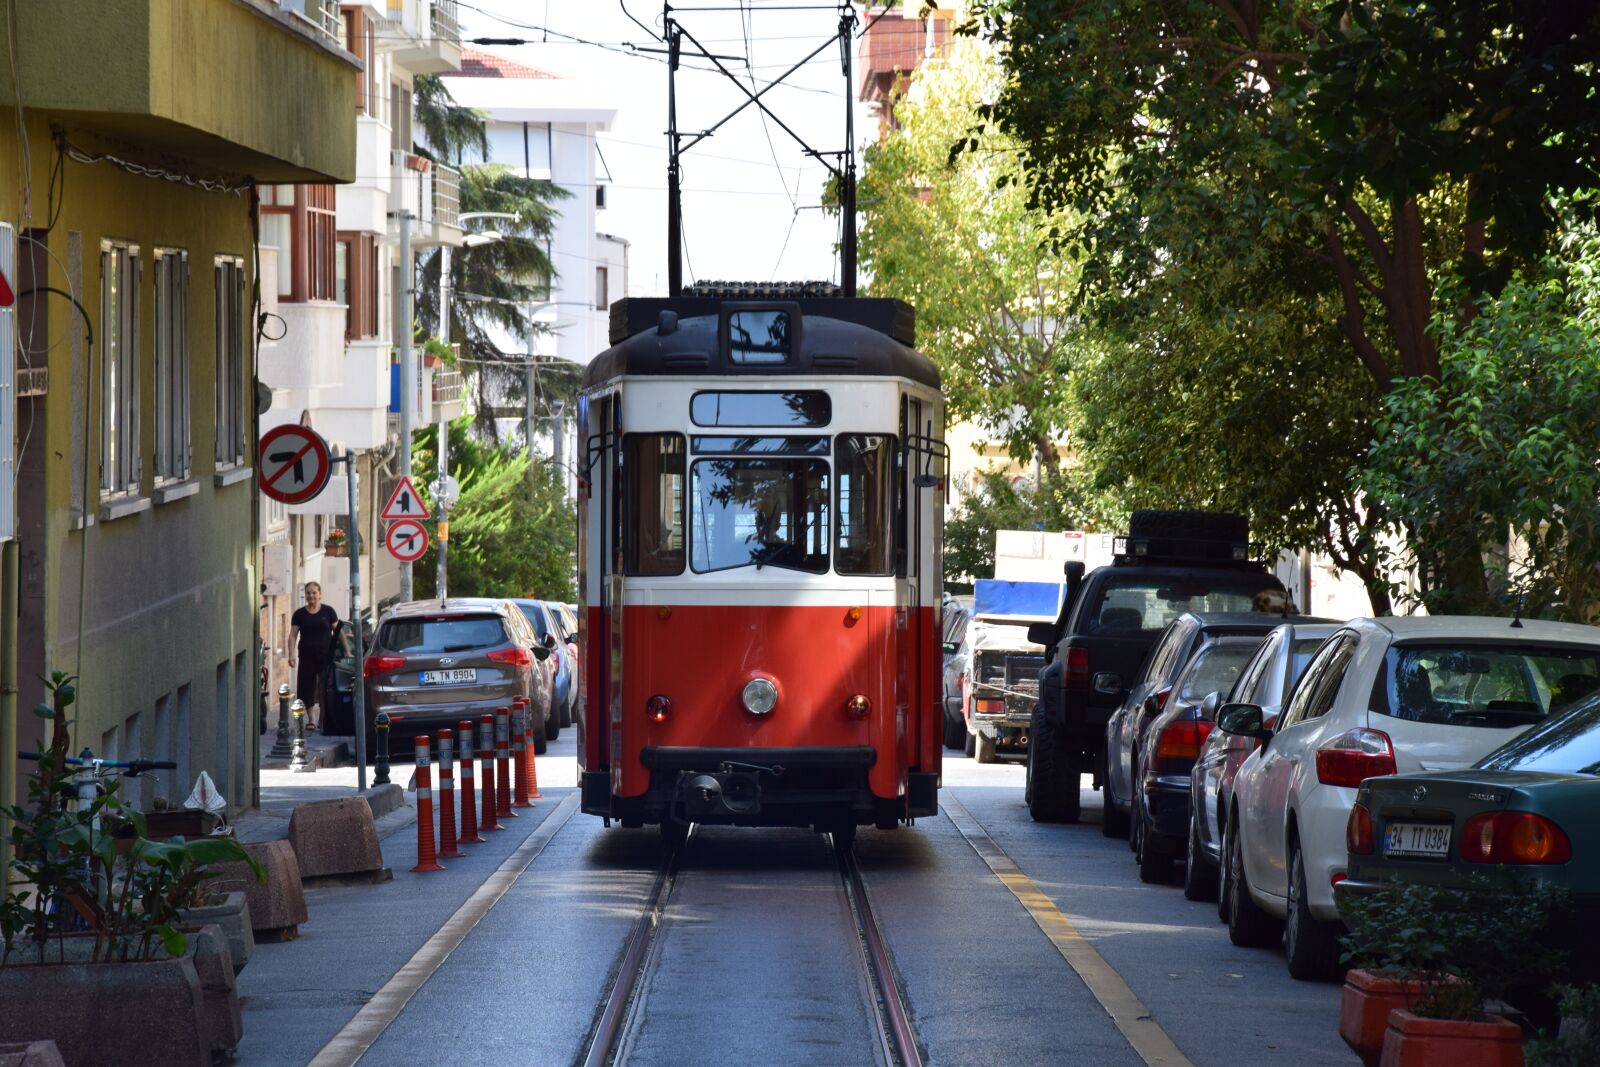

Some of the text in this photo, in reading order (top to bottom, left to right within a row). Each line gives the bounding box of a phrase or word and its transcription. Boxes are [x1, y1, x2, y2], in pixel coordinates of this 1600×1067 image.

[425, 669, 474, 682] 34 TN 8904
[1390, 826, 1403, 849] 34
